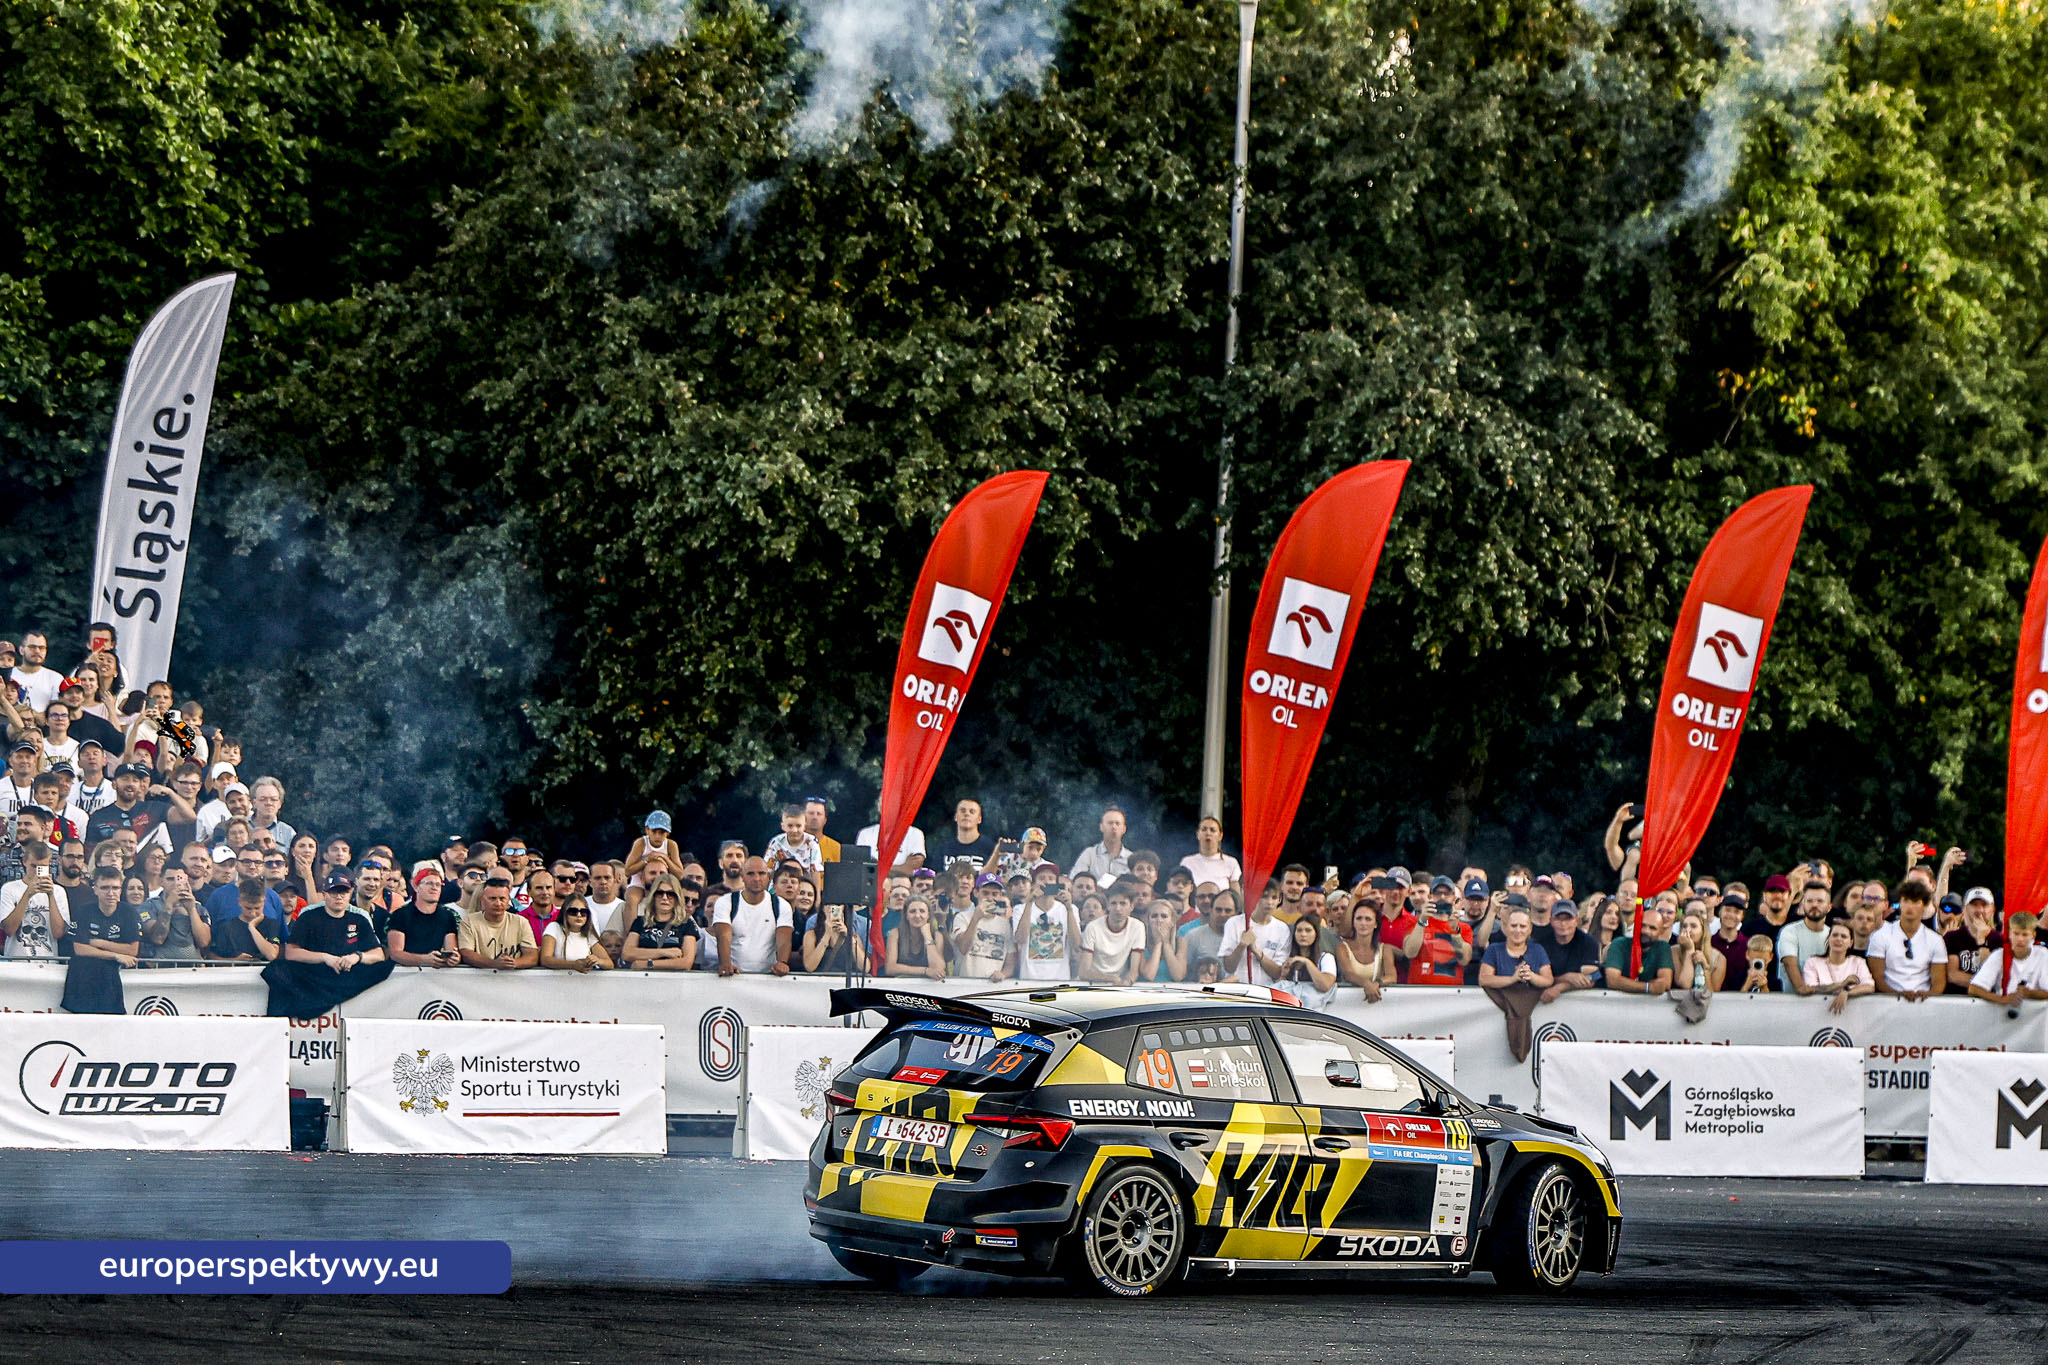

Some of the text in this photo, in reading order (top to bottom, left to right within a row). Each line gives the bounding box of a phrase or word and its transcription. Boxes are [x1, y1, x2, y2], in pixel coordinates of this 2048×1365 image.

[103, 393, 196, 623] Śląskie.
[916, 710, 944, 731] OIL
[1271, 705, 1298, 728] OIL
[1688, 728, 1719, 751] OIL
[461, 1056, 580, 1072] Ministerstwo
[986, 1051, 1024, 1074] 19
[1138, 1048, 1175, 1088] 19
[1205, 1061, 1218, 1073] J.
[69, 1062, 237, 1088] MOTO
[1220, 1074, 1266, 1088] Pleskot
[1868, 1069, 1930, 1090] STADIO
[461, 1079, 620, 1100] Sportu i Turystyki
[1685, 1087, 1774, 1103] Górnośląsko
[64, 1096, 221, 1112] WIZJA
[1068, 1099, 1196, 1118] ENERGY. NOW!
[1404, 1122, 1432, 1132] ORLEN
[1406, 1131, 1417, 1139] OIL
[1446, 1120, 1468, 1150] 19
[1685, 1121, 1764, 1137] Metropolia
